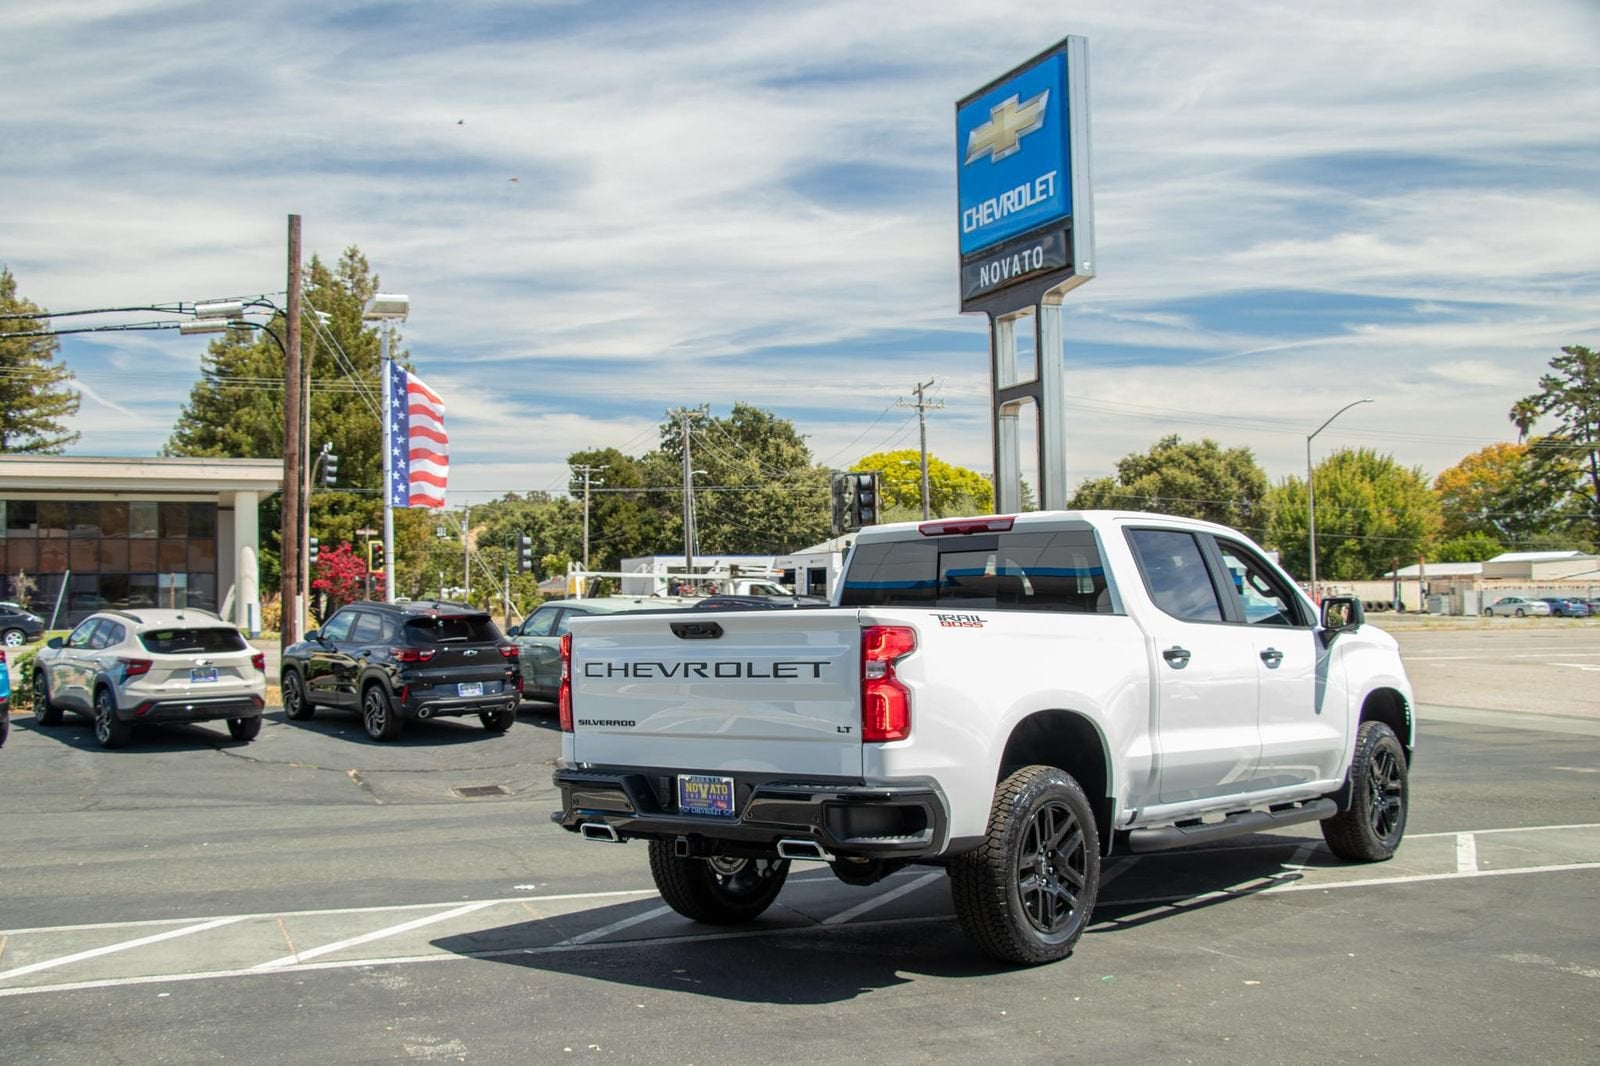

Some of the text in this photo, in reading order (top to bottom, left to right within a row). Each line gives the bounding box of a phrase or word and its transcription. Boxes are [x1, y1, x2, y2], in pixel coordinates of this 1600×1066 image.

[963, 169, 1057, 233] CHEVROLET
[980, 246, 1043, 288] NOVATO
[929, 613, 988, 622] TRAIL
[584, 661, 831, 678] CHEVROLET
[578, 719, 636, 727] SILVERADO
[837, 725, 852, 734] LT
[685, 782, 728, 800] NOVATO
